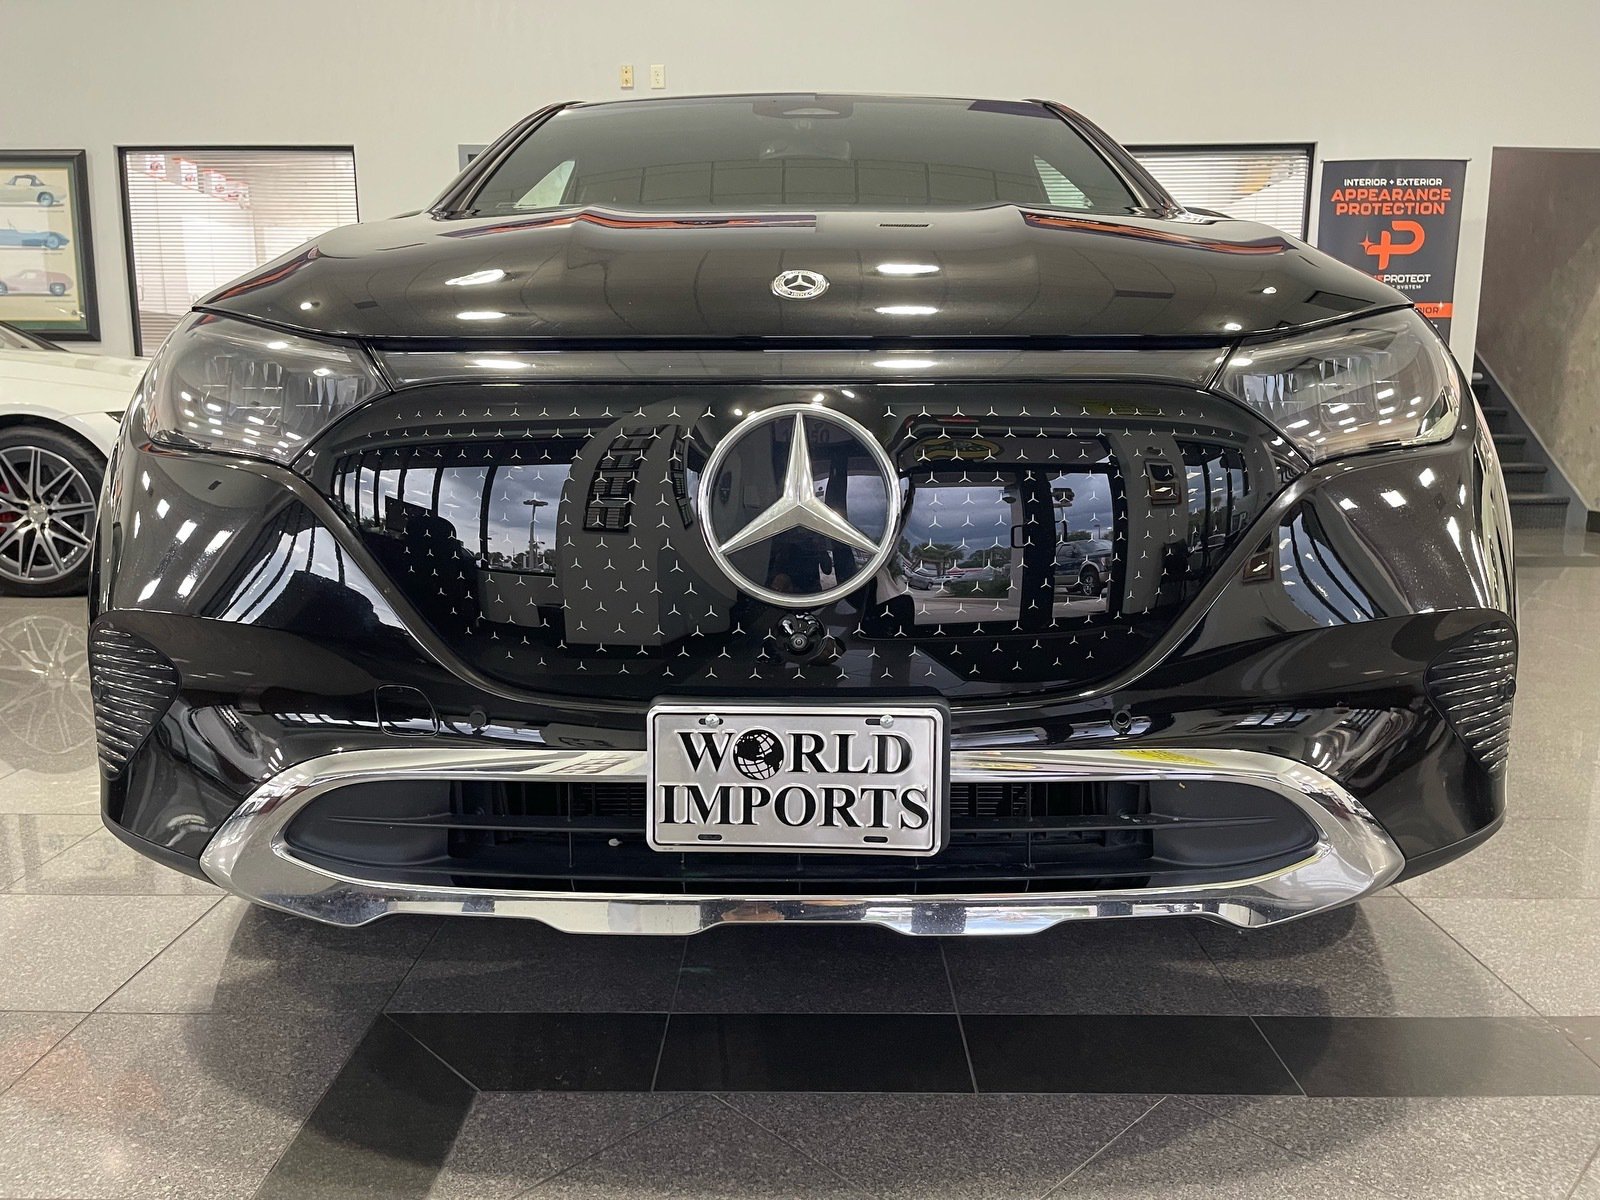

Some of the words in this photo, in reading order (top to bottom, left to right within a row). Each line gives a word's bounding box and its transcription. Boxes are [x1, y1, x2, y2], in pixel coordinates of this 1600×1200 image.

[1344, 178, 1387, 187] INTERIOR
[1396, 178, 1443, 187] EXTERIOR
[1331, 188, 1452, 202] APPEARANCE
[1336, 202, 1445, 215] PROTECTION
[677, 729, 912, 780] WORLD
[659, 784, 930, 829] IMPORTS
